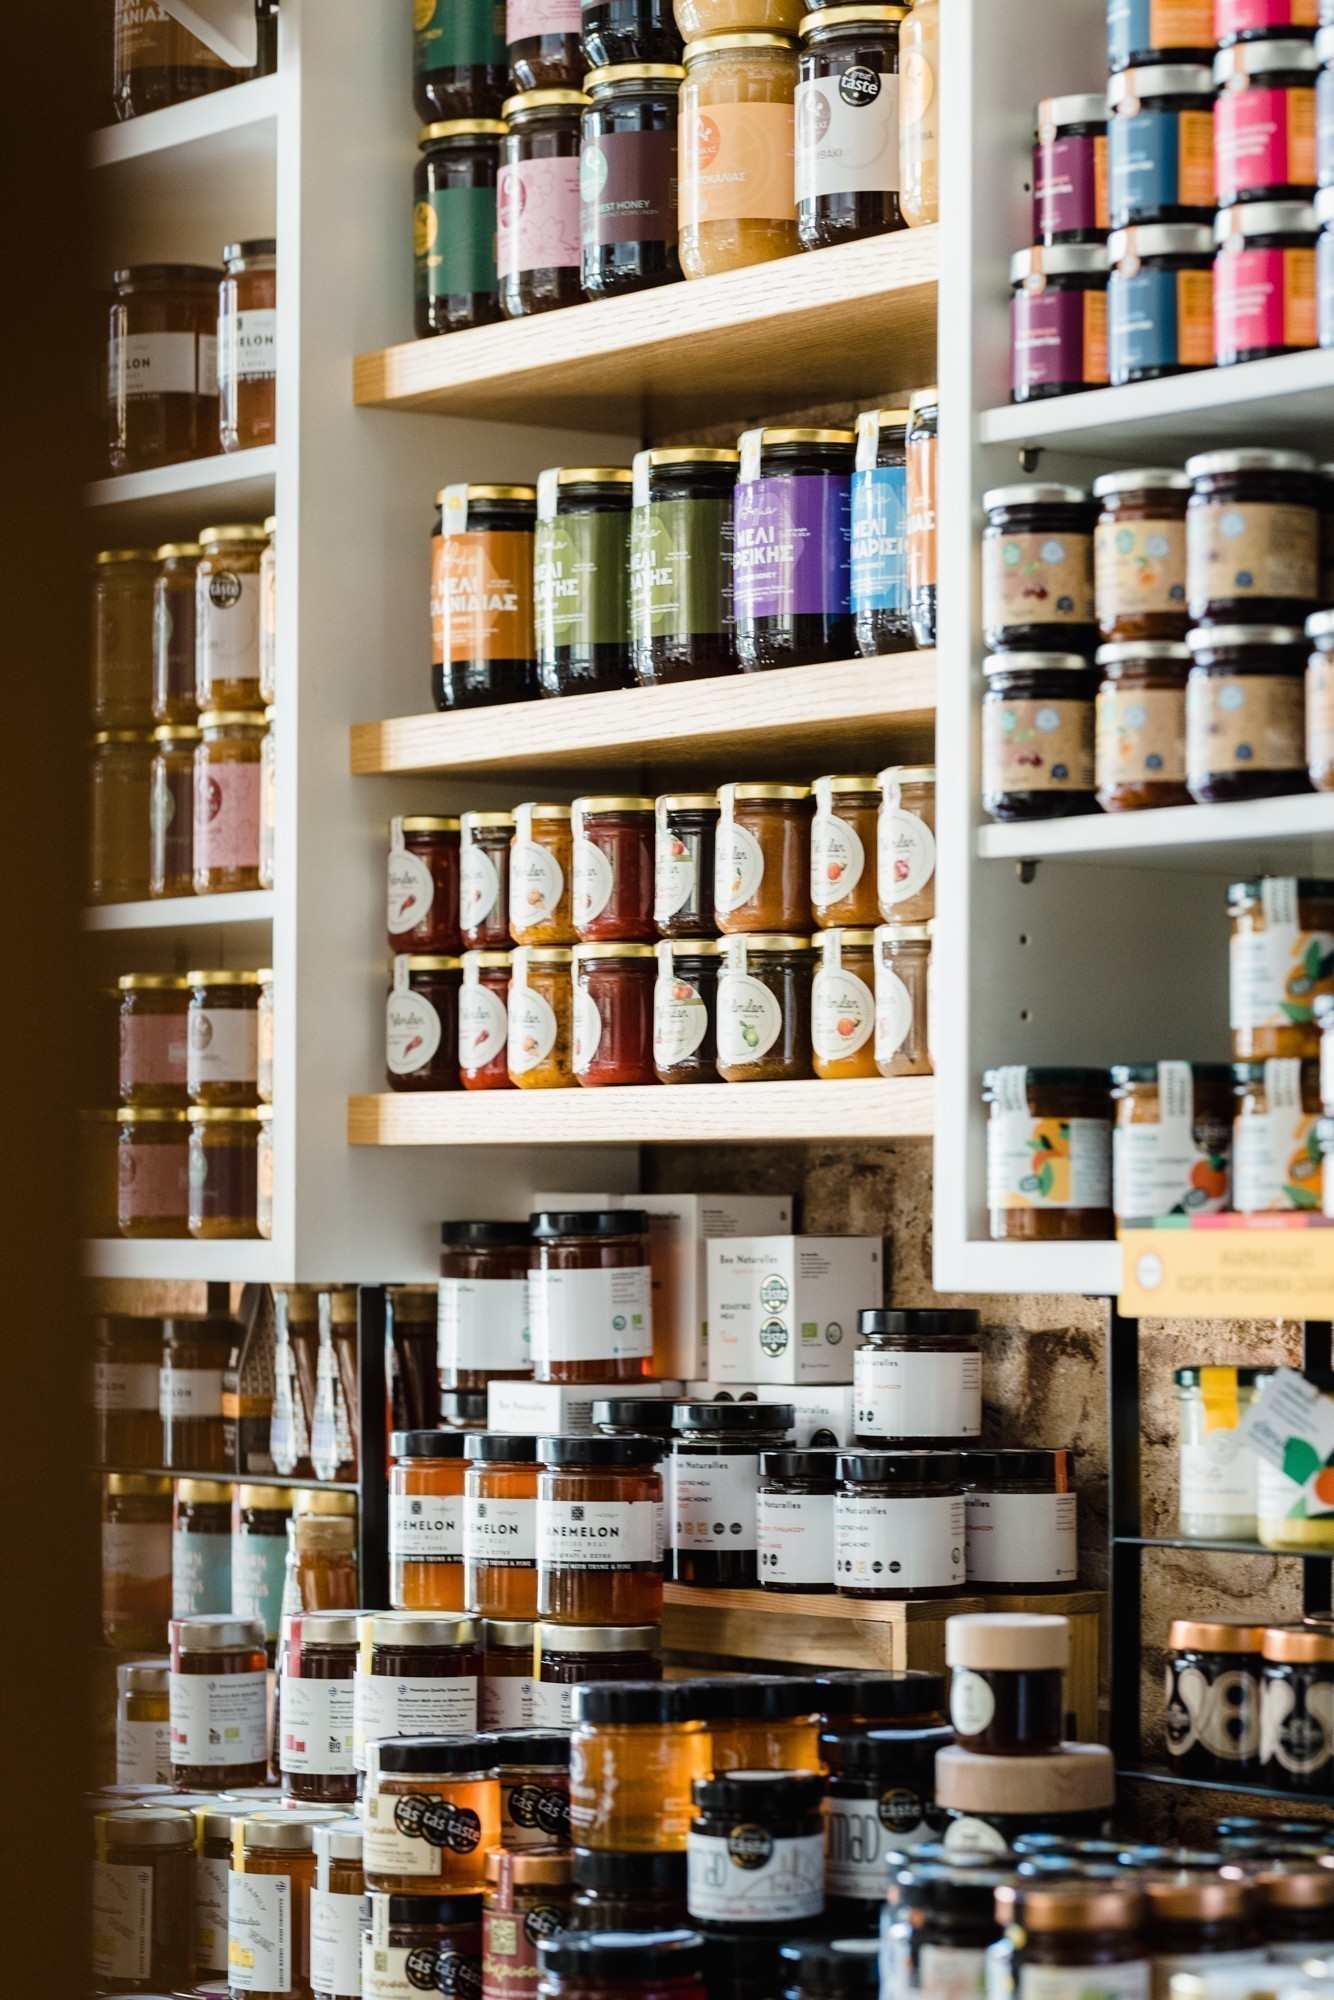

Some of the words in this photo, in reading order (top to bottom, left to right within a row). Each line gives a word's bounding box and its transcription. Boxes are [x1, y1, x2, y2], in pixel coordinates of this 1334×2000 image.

[841, 75, 878, 95] taste
[617, 200, 651, 210] HONEY
[512, 1794, 534, 1811] tas
[538, 1799, 560, 1818] tas
[397, 1804, 421, 1822] tas
[423, 1812, 446, 1830] tas
[448, 1819, 481, 1843] taste
[527, 1913, 552, 1934] tas
[407, 1956, 432, 1974] tas
[435, 1957, 456, 1975] tas
